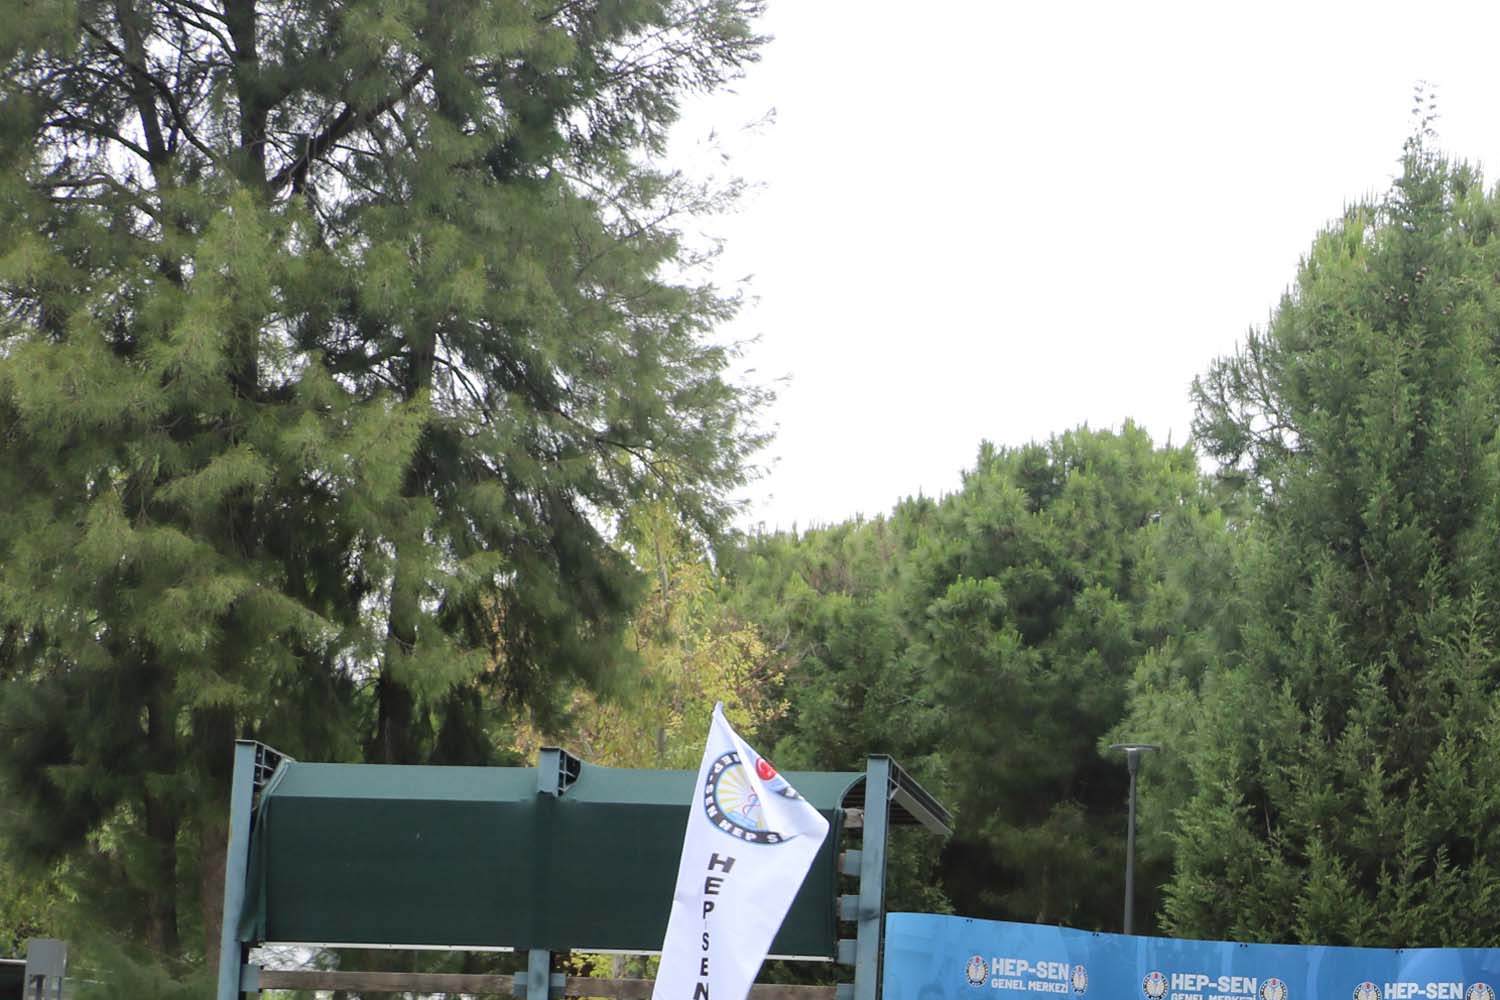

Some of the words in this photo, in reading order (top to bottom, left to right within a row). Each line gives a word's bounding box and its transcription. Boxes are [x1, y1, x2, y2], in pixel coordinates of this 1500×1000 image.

[991, 957, 1069, 981] HEP-SEN
[991, 978, 1026, 991] GENEL
[1028, 980, 1069, 993] MERKEZİ
[1171, 973, 1257, 994] HEP-SEN
[1384, 982, 1463, 1000] HEP-SEN
